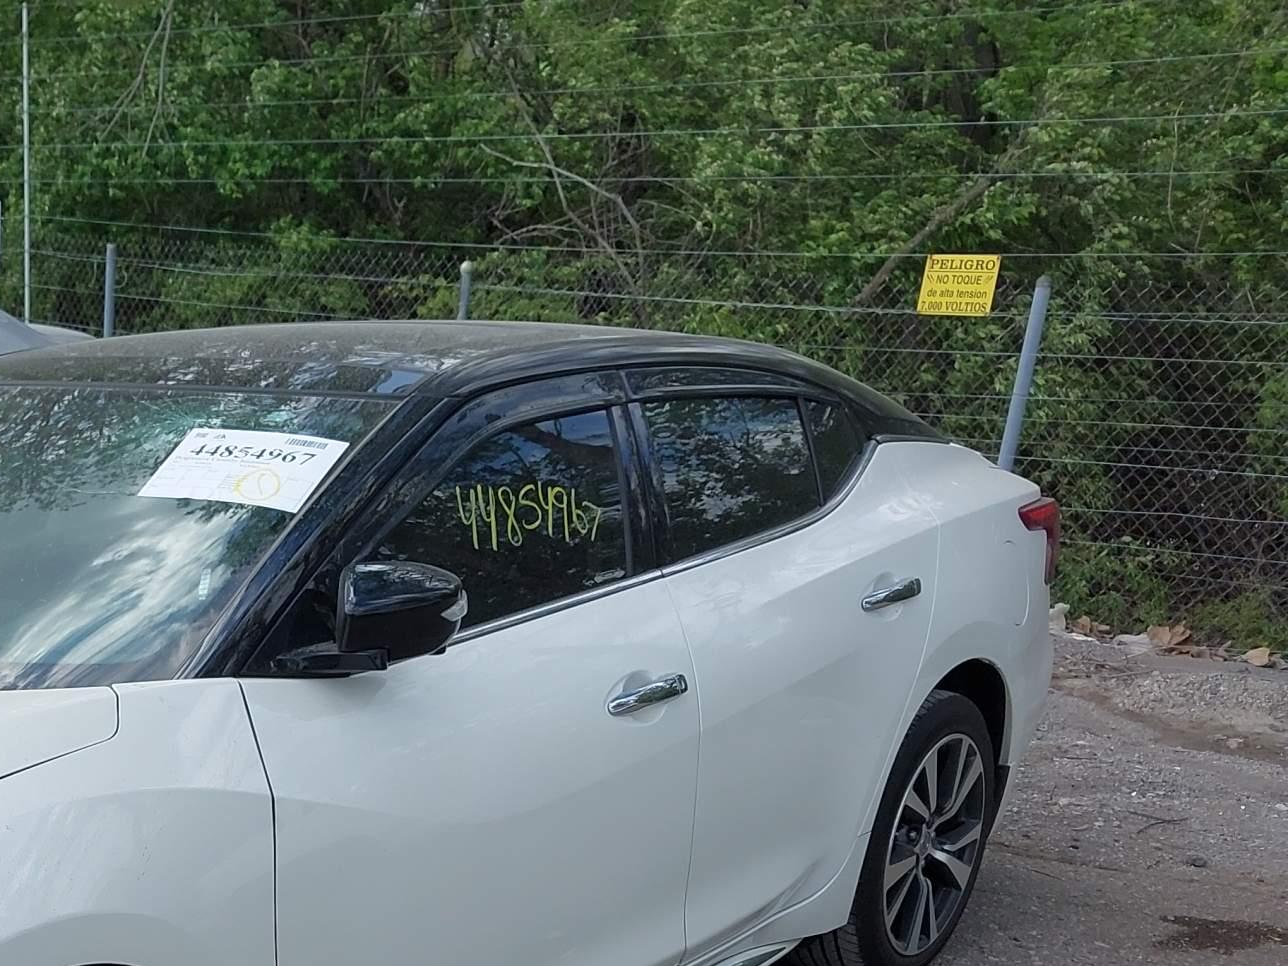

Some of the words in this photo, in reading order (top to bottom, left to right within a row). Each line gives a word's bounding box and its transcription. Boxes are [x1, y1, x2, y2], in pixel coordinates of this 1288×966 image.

[928, 258, 997, 271] PELIGRO
[935, 274, 950, 285] NO
[952, 274, 983, 286] TOQUE
[926, 287, 938, 298] de
[939, 288, 954, 298] alta
[956, 289, 988, 299] tension
[945, 301, 988, 313] VOLTIOS
[189, 443, 319, 466] 44854967
[455, 480, 602, 552] 44854967
